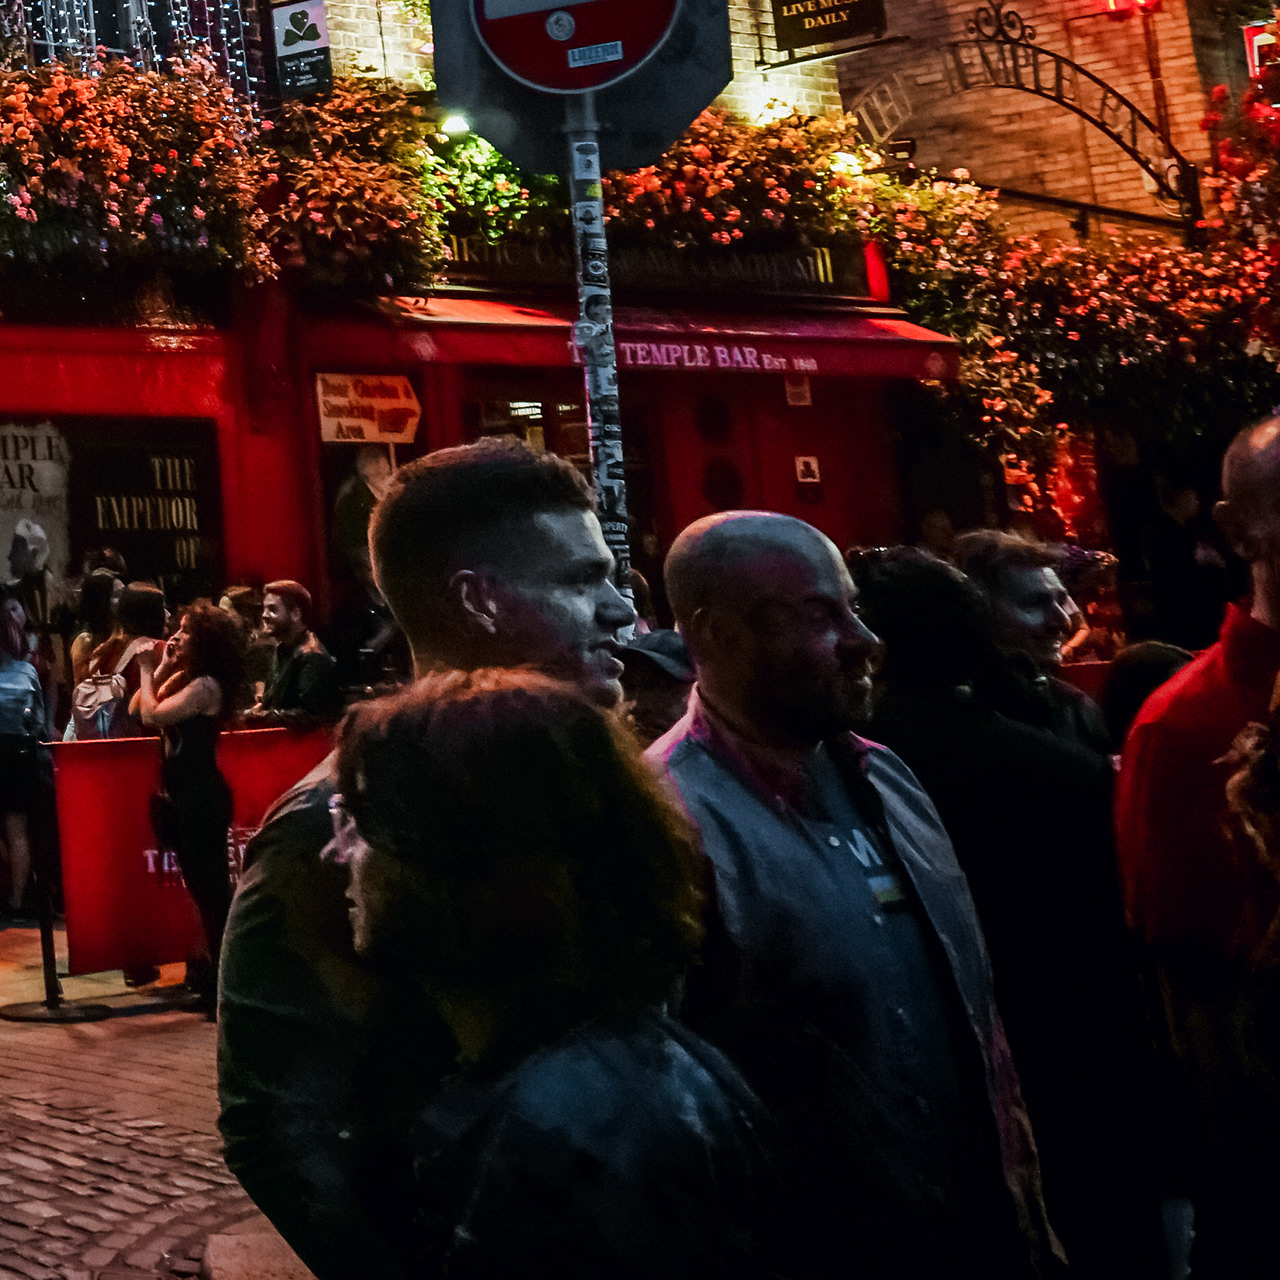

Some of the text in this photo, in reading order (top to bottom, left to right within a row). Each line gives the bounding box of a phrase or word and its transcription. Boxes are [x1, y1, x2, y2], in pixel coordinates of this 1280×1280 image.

[782, 0, 818, 17] LIVE
[803, 9, 850, 29] DAILY
[619, 341, 712, 368] TEMPLE
[713, 344, 760, 369] BAR
[151, 456, 197, 491] THE
[94, 495, 199, 531] EMPEROR
